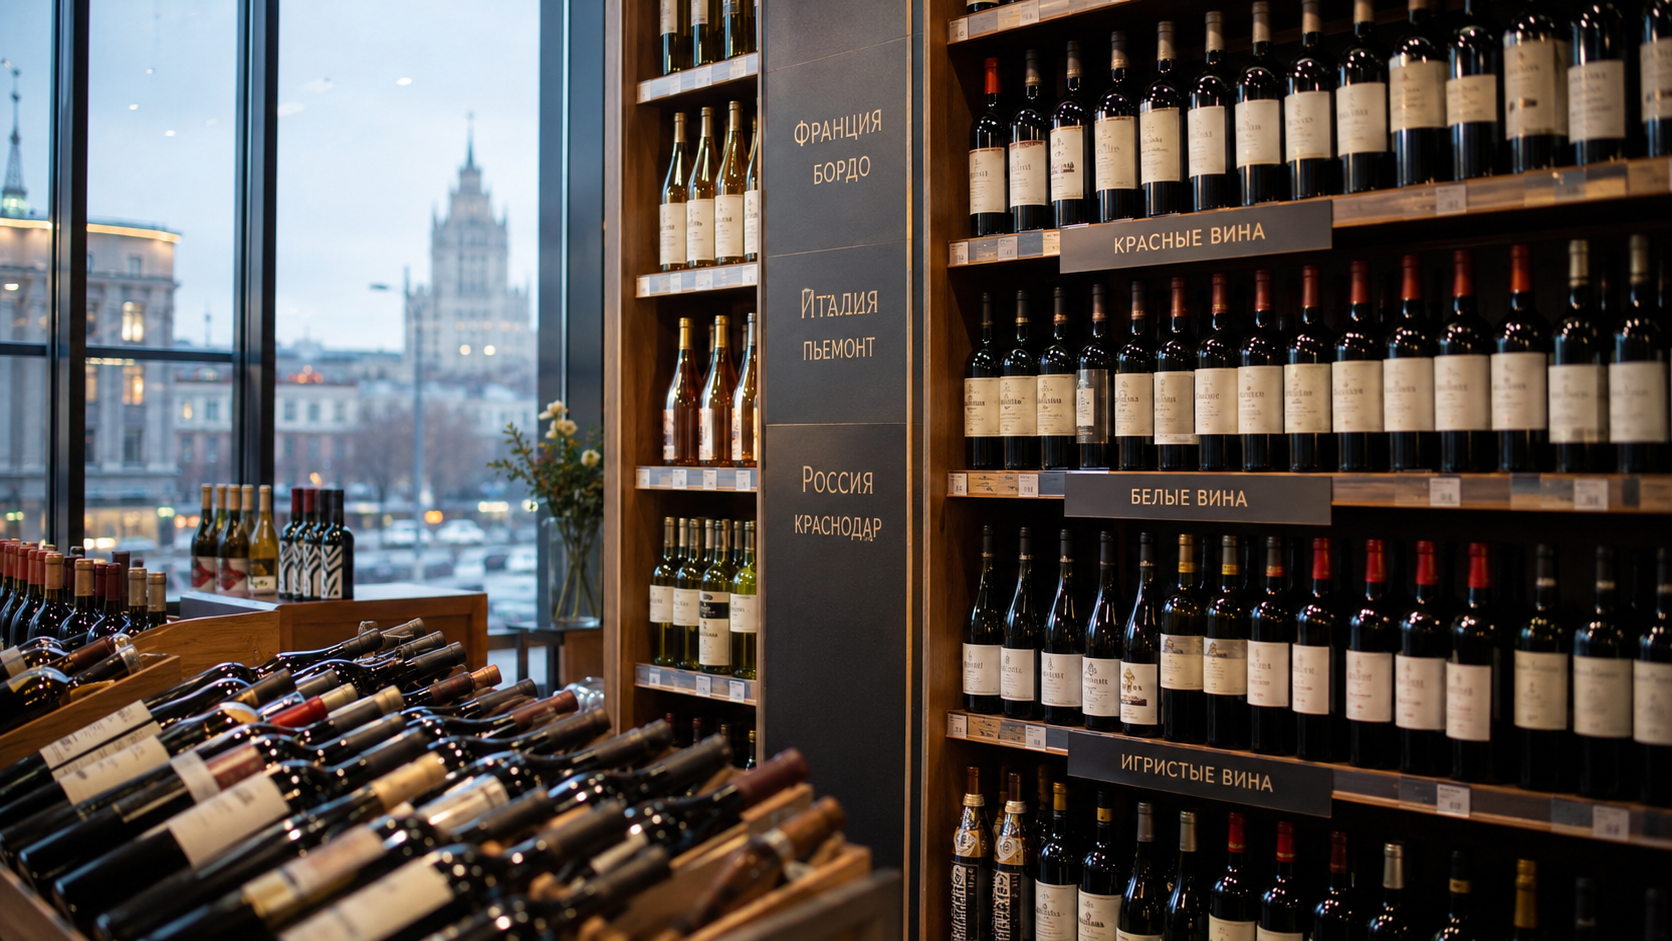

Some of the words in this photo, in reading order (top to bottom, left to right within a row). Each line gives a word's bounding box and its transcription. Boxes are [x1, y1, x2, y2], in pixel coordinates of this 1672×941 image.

[794, 108, 882, 147] ФРАНЦИЯ
[813, 155, 871, 185] БОРДО
[1114, 228, 1203, 255] КРАСНЫЕ
[1210, 222, 1266, 245] ВИНА
[803, 336, 876, 363] ПЬЕМОНТ
[1131, 488, 1190, 506] БЕЛЫЕ
[1197, 489, 1248, 508] ВИНА
[794, 514, 882, 542] КРАСНОДАР
[1121, 753, 1215, 783] ИГРИСТЫЕ
[1222, 768, 1274, 793] ВИНА
